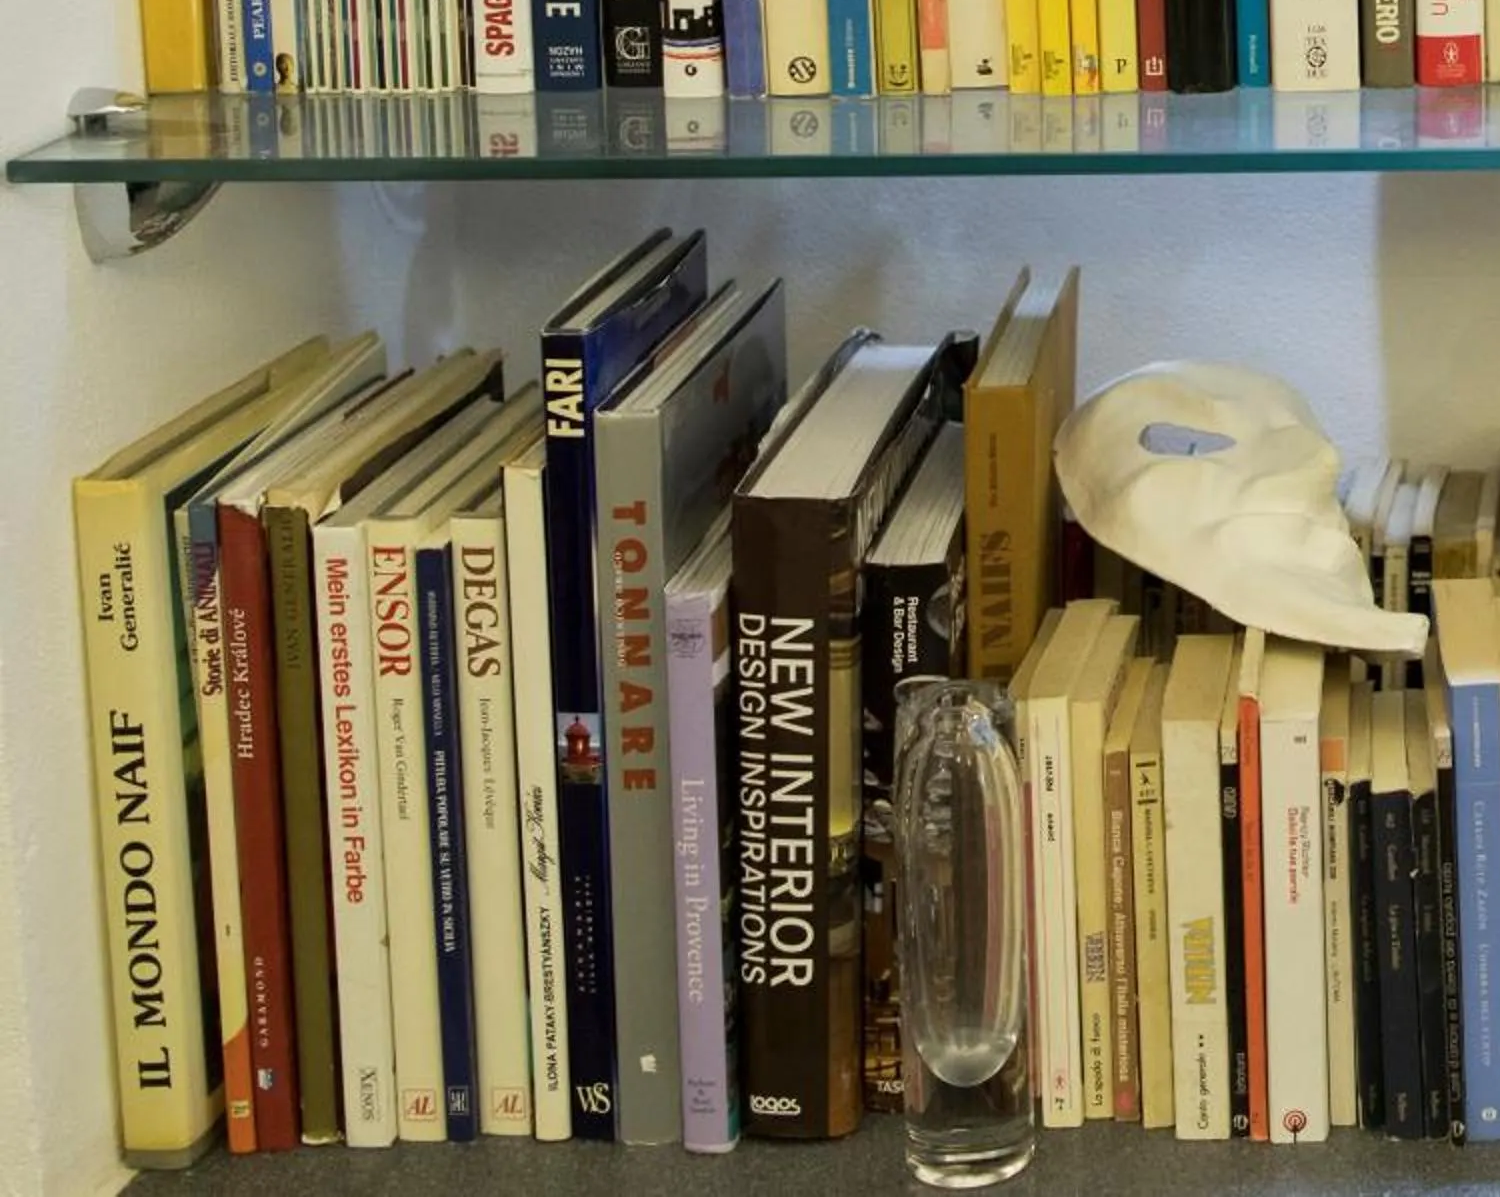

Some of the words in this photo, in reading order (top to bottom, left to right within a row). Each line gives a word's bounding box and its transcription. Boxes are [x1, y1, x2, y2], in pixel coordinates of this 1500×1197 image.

[545, 360, 583, 438] FARI
[96, 573, 114, 624] Ivan
[111, 542, 139, 652] Generalić
[193, 541, 220, 624] ANIMALI
[326, 558, 349, 615] Mein
[370, 544, 411, 677] ENSOR
[460, 545, 501, 677] DEGAS
[892, 596, 905, 605] &
[893, 608, 906, 629] Bar
[198, 627, 220, 645] di
[227, 608, 251, 683] Králové
[331, 622, 354, 698] erstes
[612, 501, 657, 792] TONNARE
[890, 632, 906, 673] Design
[907, 596, 919, 663] Restaurant
[199, 648, 223, 697] Storie
[737, 613, 765, 737] DESIGN
[769, 615, 814, 736] NEW
[233, 689, 256, 759] Hradec
[334, 704, 361, 800] Lexikon
[109, 710, 152, 826] NAIF
[341, 805, 362, 828] in
[678, 778, 706, 857] Living
[343, 835, 367, 903] Farbe
[682, 862, 703, 887] in
[740, 751, 767, 984] INSPIRATIONS
[769, 753, 814, 987] INTERIOR
[120, 841, 168, 1029] MONDO
[682, 894, 708, 1002] Provence
[137, 1048, 173, 1091] IL
